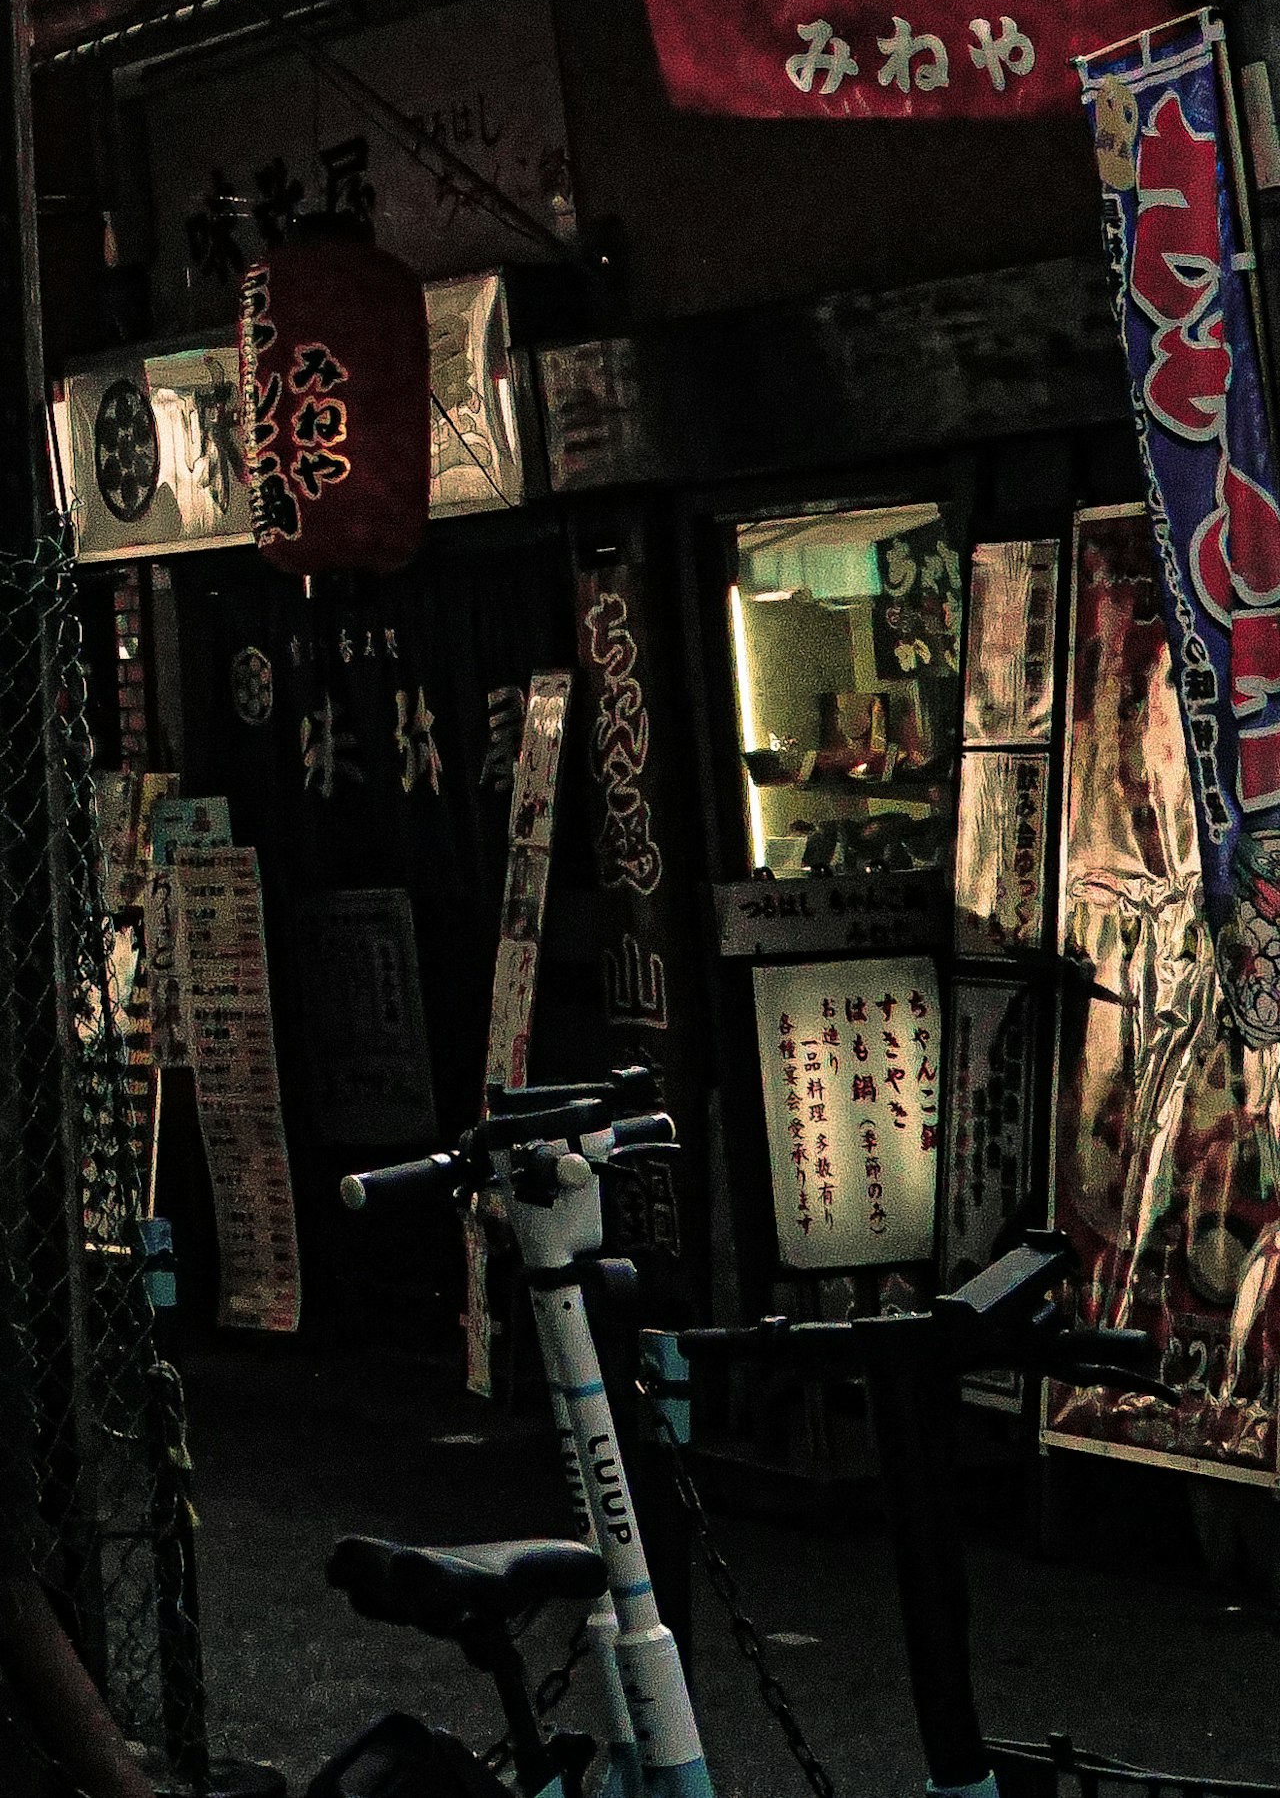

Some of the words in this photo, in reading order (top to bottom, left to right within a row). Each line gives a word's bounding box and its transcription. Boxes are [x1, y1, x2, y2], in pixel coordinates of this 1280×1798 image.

[785, 15, 1036, 95] みねや
[290, 343, 349, 498] みねや
[801, 1040, 827, 1122] 一品料理
[822, 998, 841, 1075] お造り
[845, 997, 877, 1102] はも鍋
[876, 993, 907, 1129] すきやき
[909, 989, 940, 1151] ちゃんこ鍋
[589, 1434, 632, 1544] LUUP
